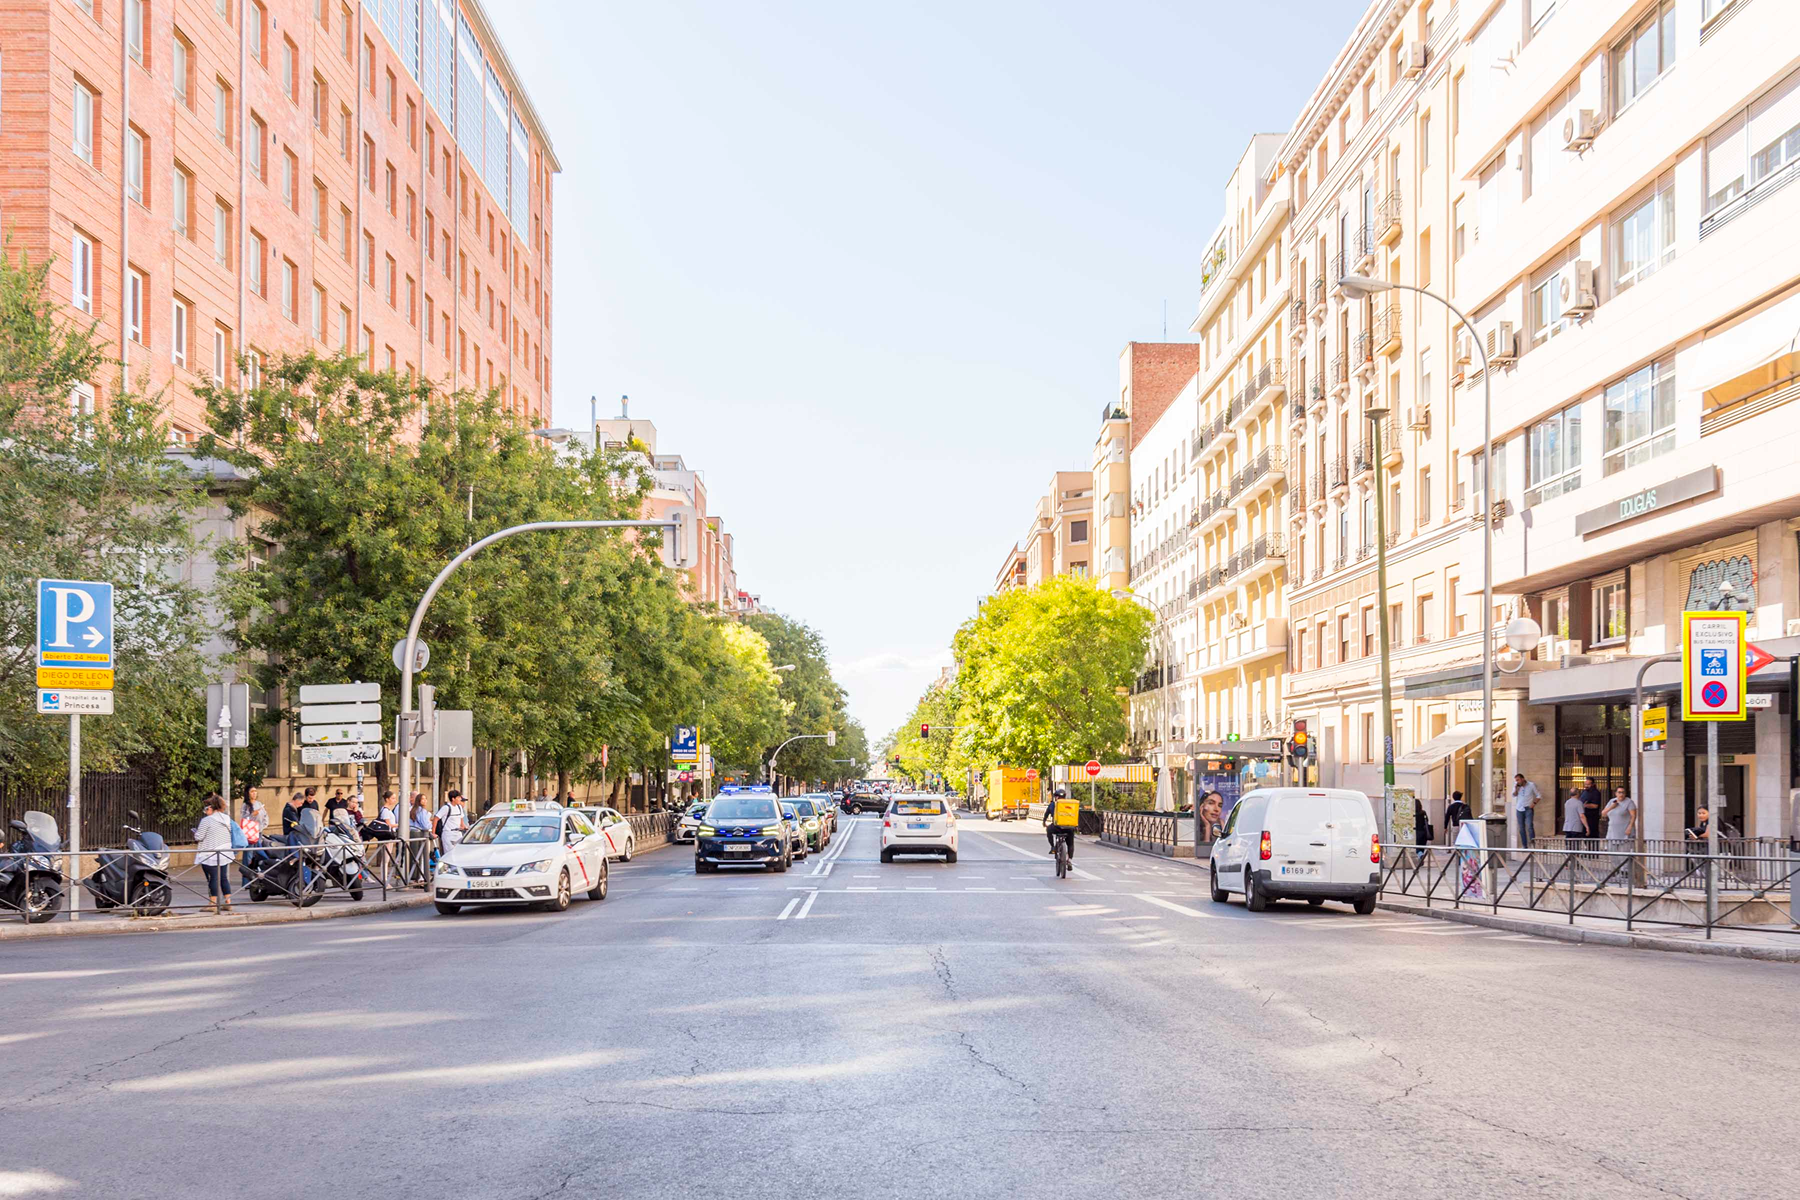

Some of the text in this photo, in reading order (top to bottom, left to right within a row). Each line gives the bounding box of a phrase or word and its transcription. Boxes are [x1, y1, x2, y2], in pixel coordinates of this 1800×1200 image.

[1620, 490, 1657, 518] DOUGLAS
[48, 587, 95, 647] P
[42, 671, 70, 679] DIEGO
[86, 671, 110, 680] LEÓN
[1745, 696, 1766, 704] eón
[679, 728, 690, 744] P
